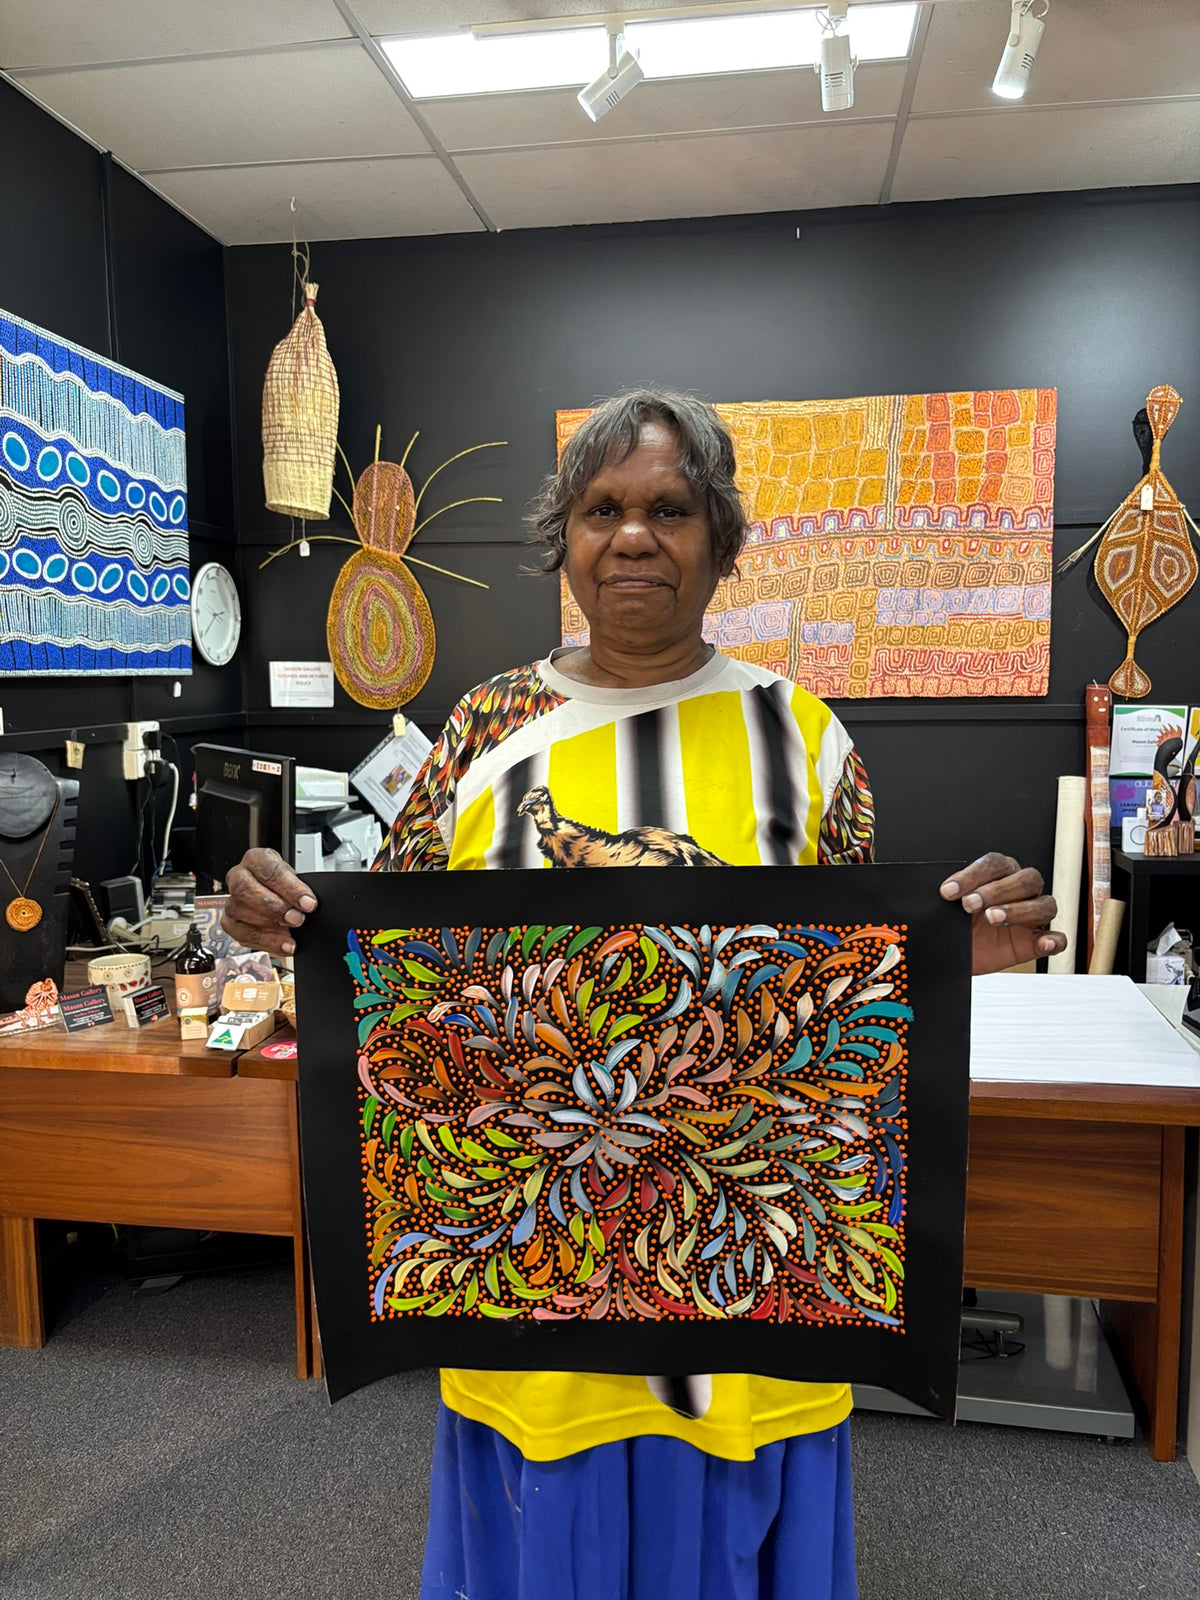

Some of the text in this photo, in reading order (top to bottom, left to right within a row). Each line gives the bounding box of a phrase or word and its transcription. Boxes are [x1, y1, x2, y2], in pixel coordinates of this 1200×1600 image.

[60, 988, 102, 1001] Mason Gallery
[134, 995, 148, 1004] Mason
[148, 990, 163, 999] Gallery
[62, 1003, 84, 1012] Mason
[83, 998, 105, 1007] Gallery
